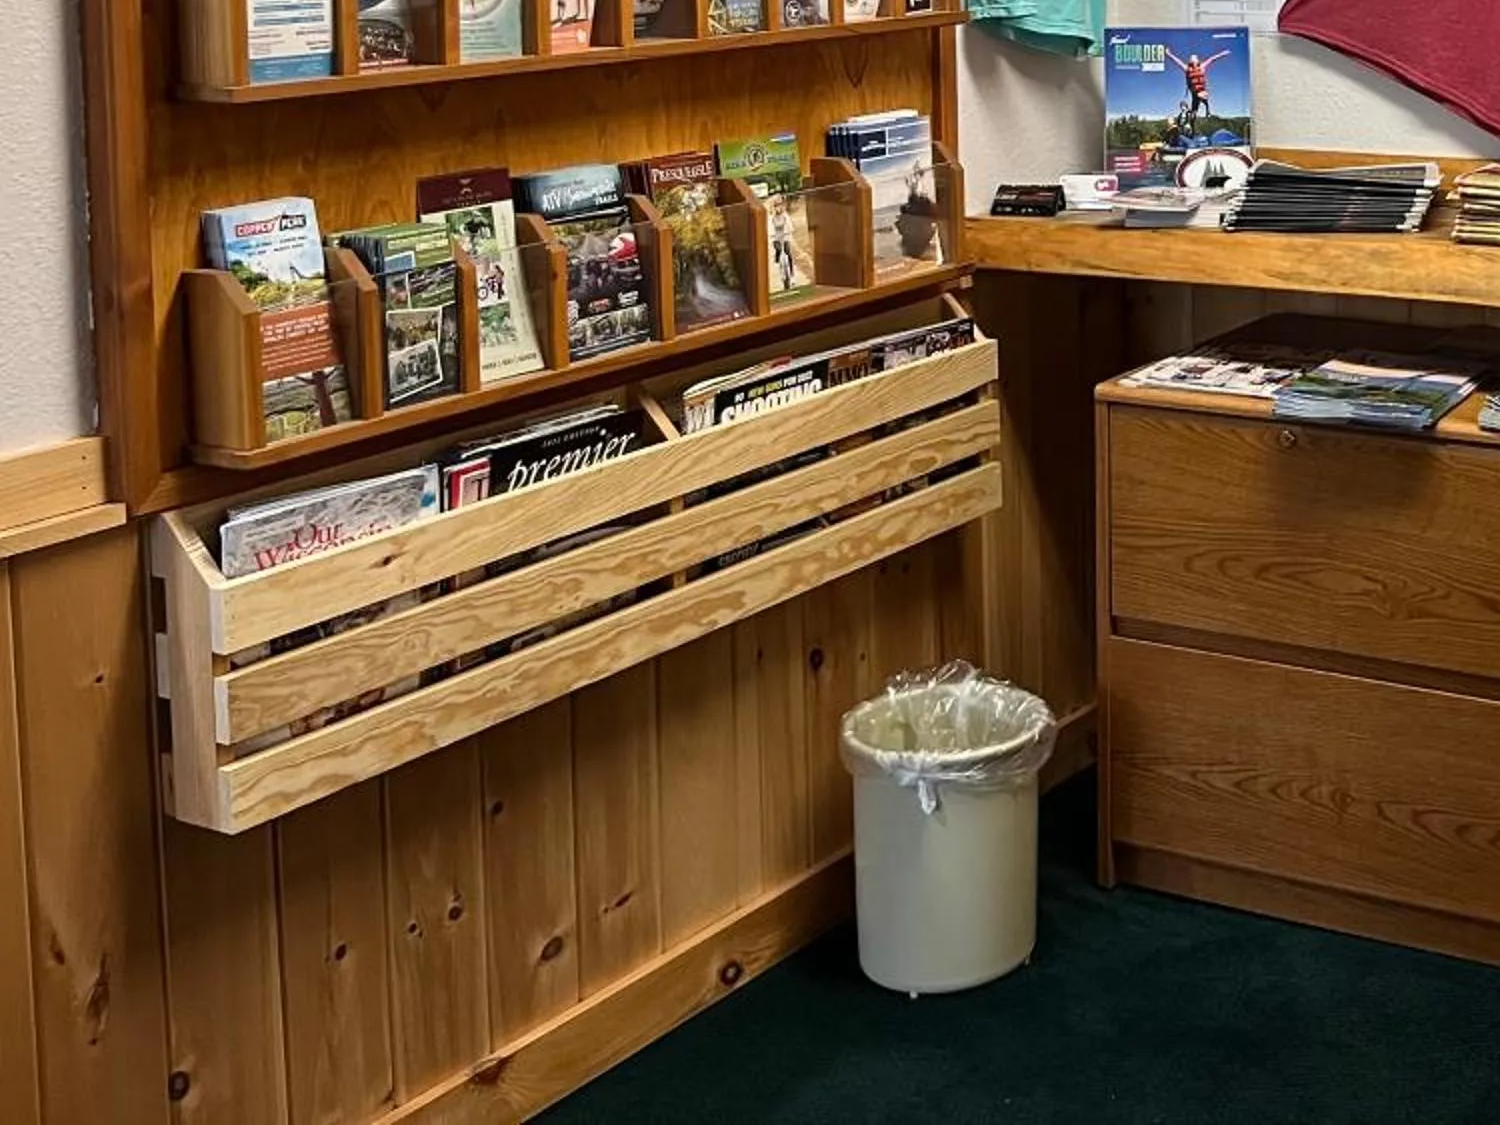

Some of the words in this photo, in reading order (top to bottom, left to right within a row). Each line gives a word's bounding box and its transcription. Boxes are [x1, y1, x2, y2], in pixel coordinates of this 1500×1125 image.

[1115, 44, 1166, 63] BOULDER
[507, 429, 637, 493] premier
[294, 523, 344, 549] Our
